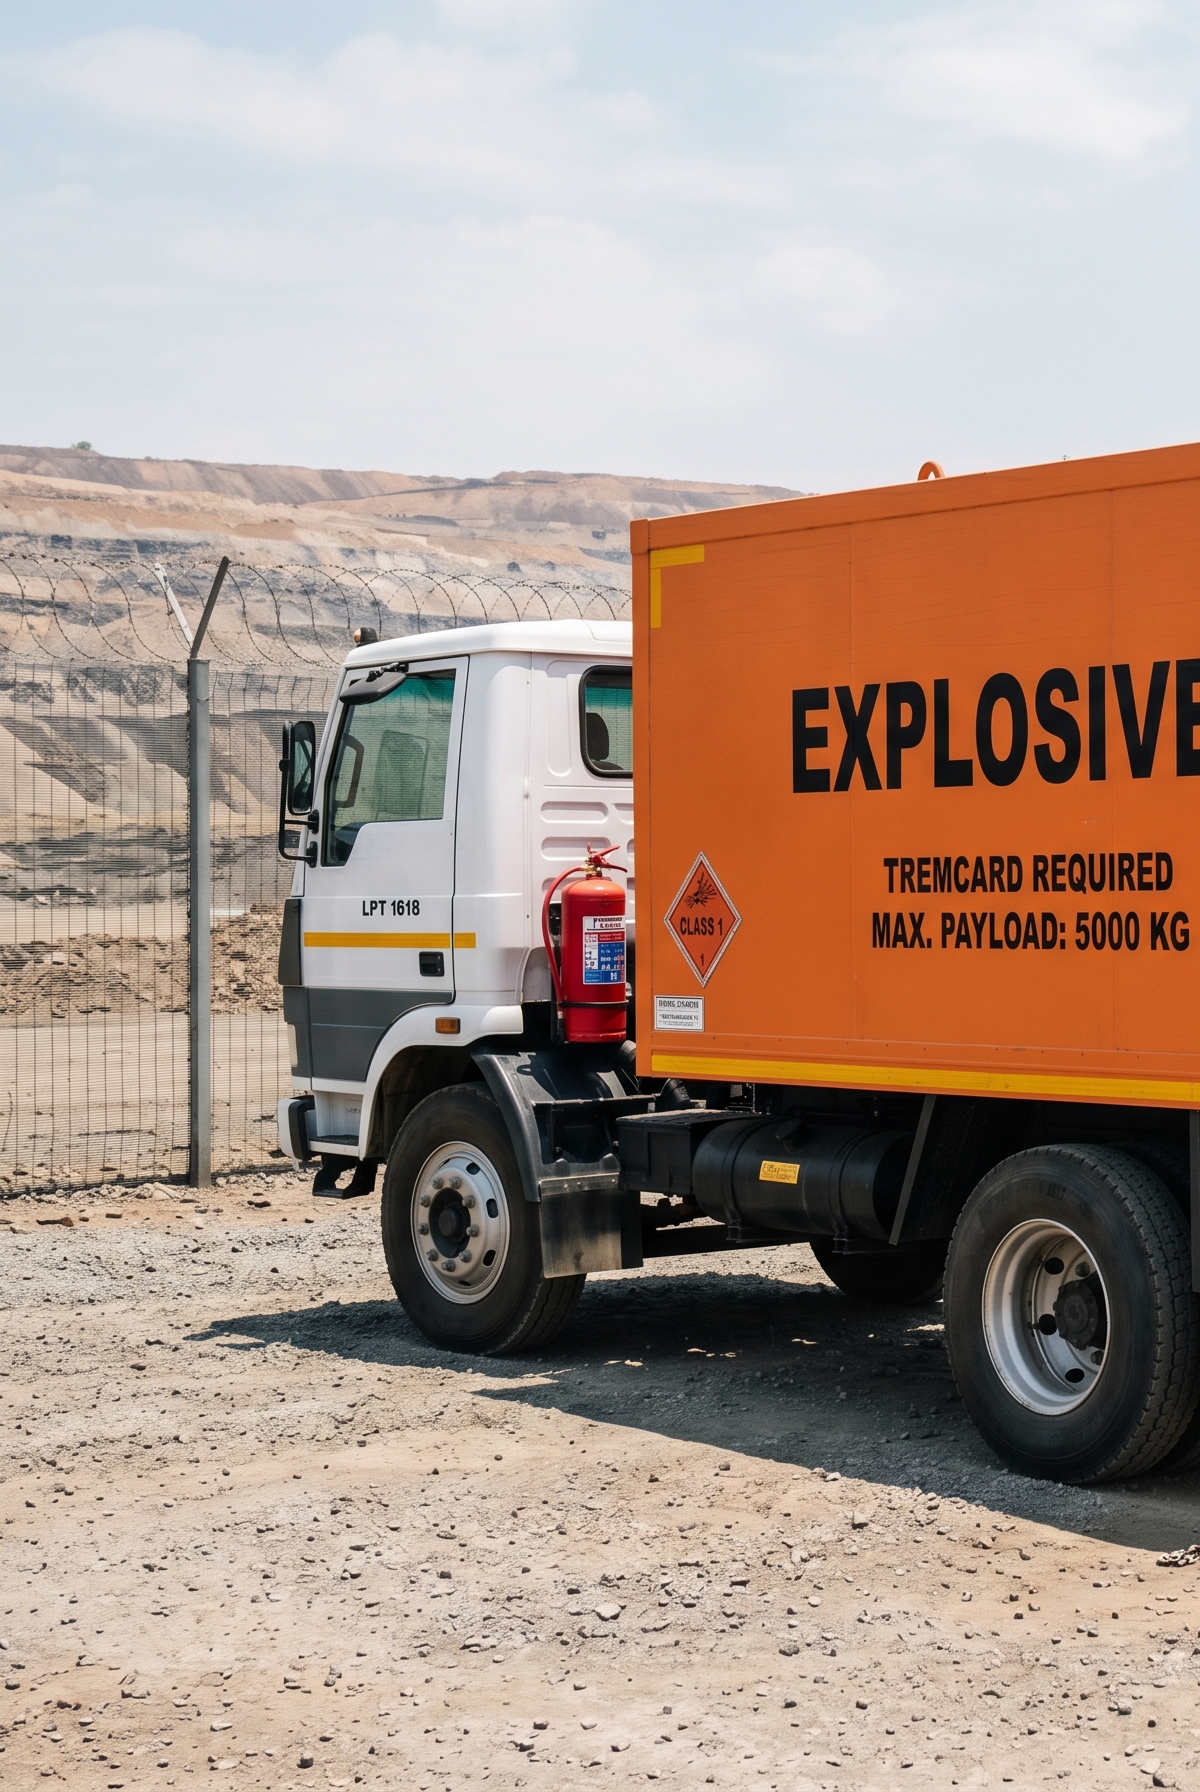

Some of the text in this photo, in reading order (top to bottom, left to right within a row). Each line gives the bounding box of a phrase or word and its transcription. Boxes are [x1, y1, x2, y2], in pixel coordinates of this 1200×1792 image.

[883, 851, 1174, 894] TREMCARD REQUIRED
[362, 899, 420, 916] LPT 1618
[680, 917, 723, 936] CLASS 1
[871, 911, 1190, 951] MAX. PAYLOAD: 5000 KG
[700, 953, 705, 966] 1
